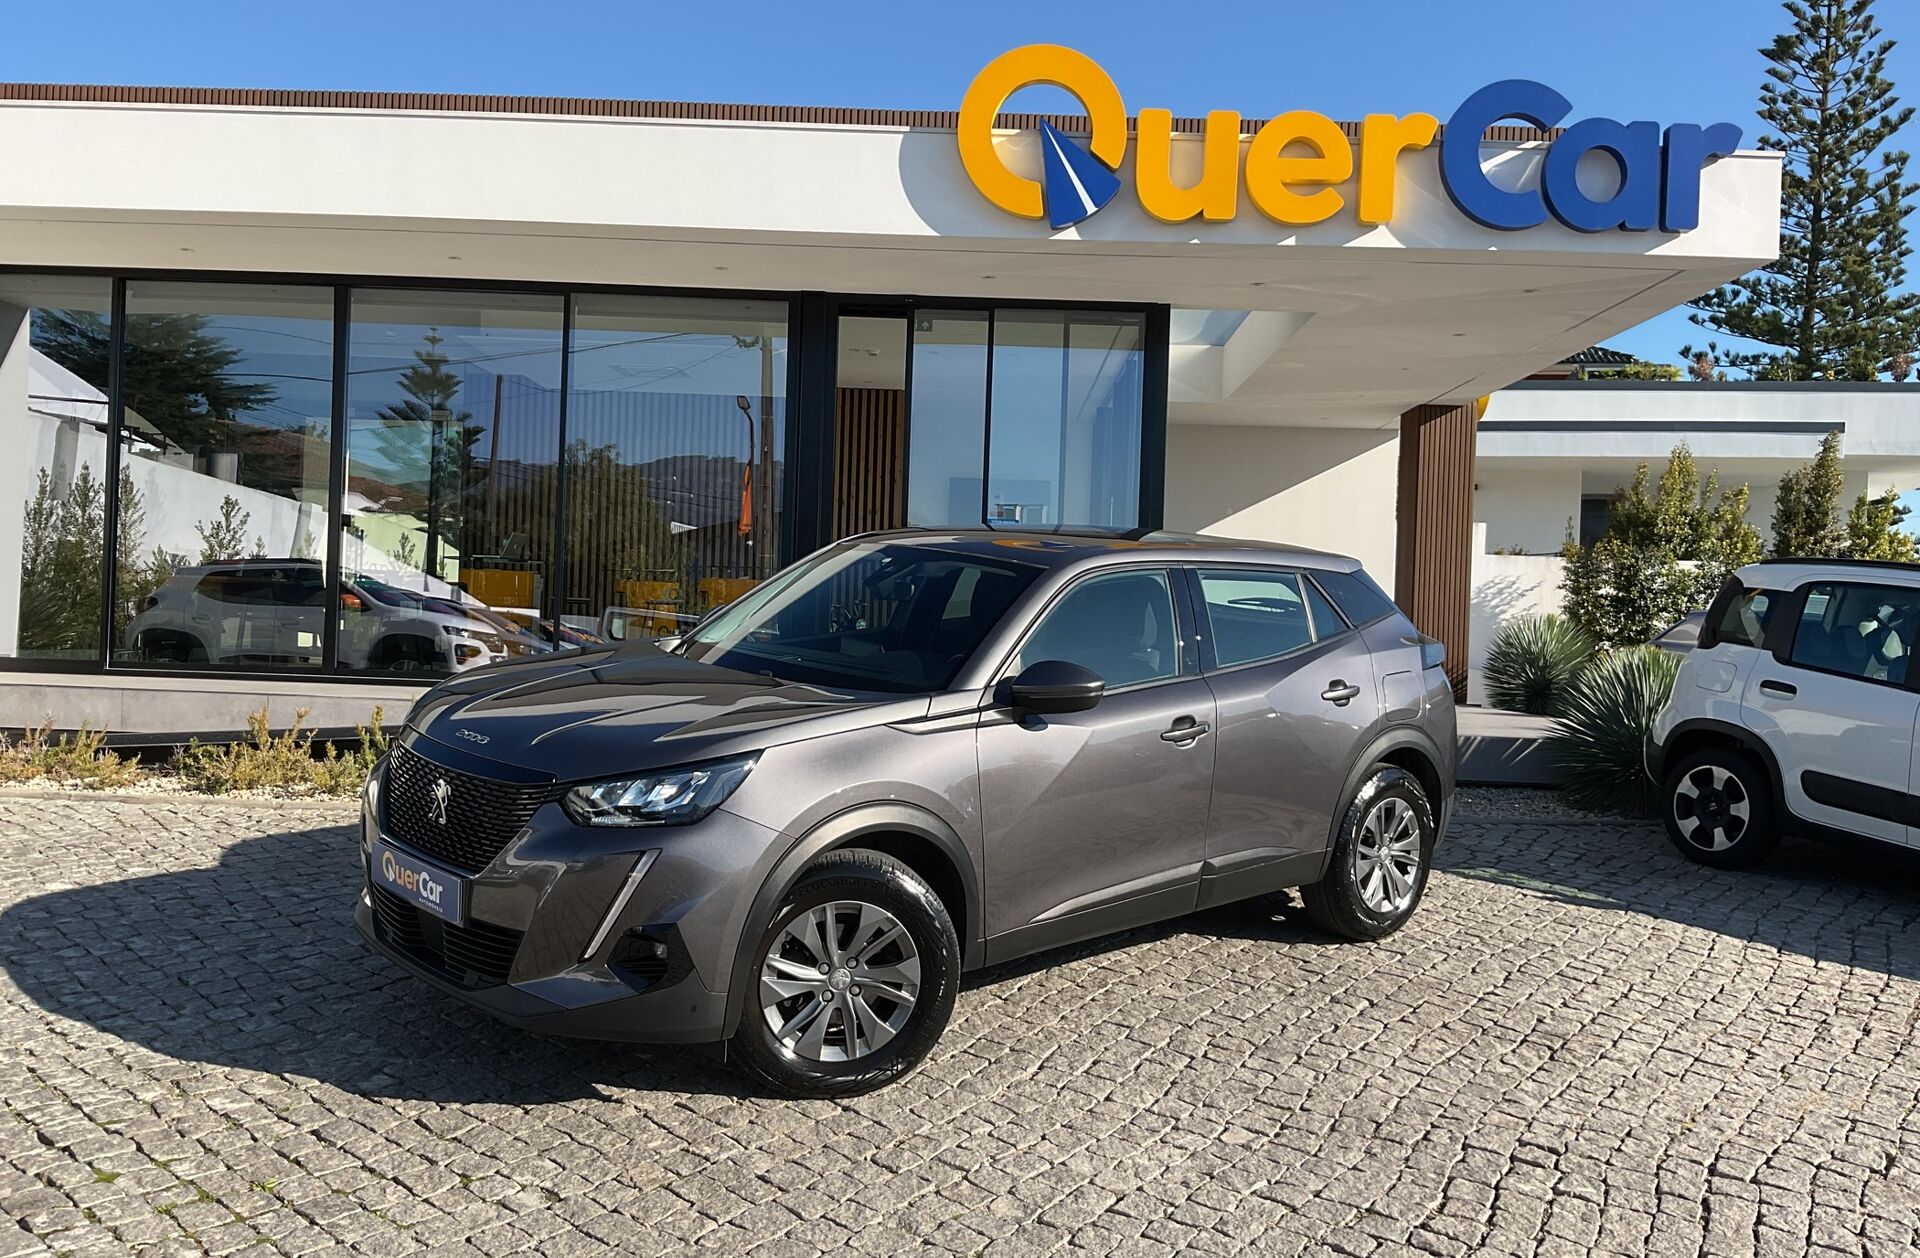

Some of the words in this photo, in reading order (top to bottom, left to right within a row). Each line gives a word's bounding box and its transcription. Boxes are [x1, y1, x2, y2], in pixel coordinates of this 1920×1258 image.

[958, 43, 1743, 233] QuerCar
[455, 728, 490, 744] 2008
[382, 851, 443, 904] QuerCar
